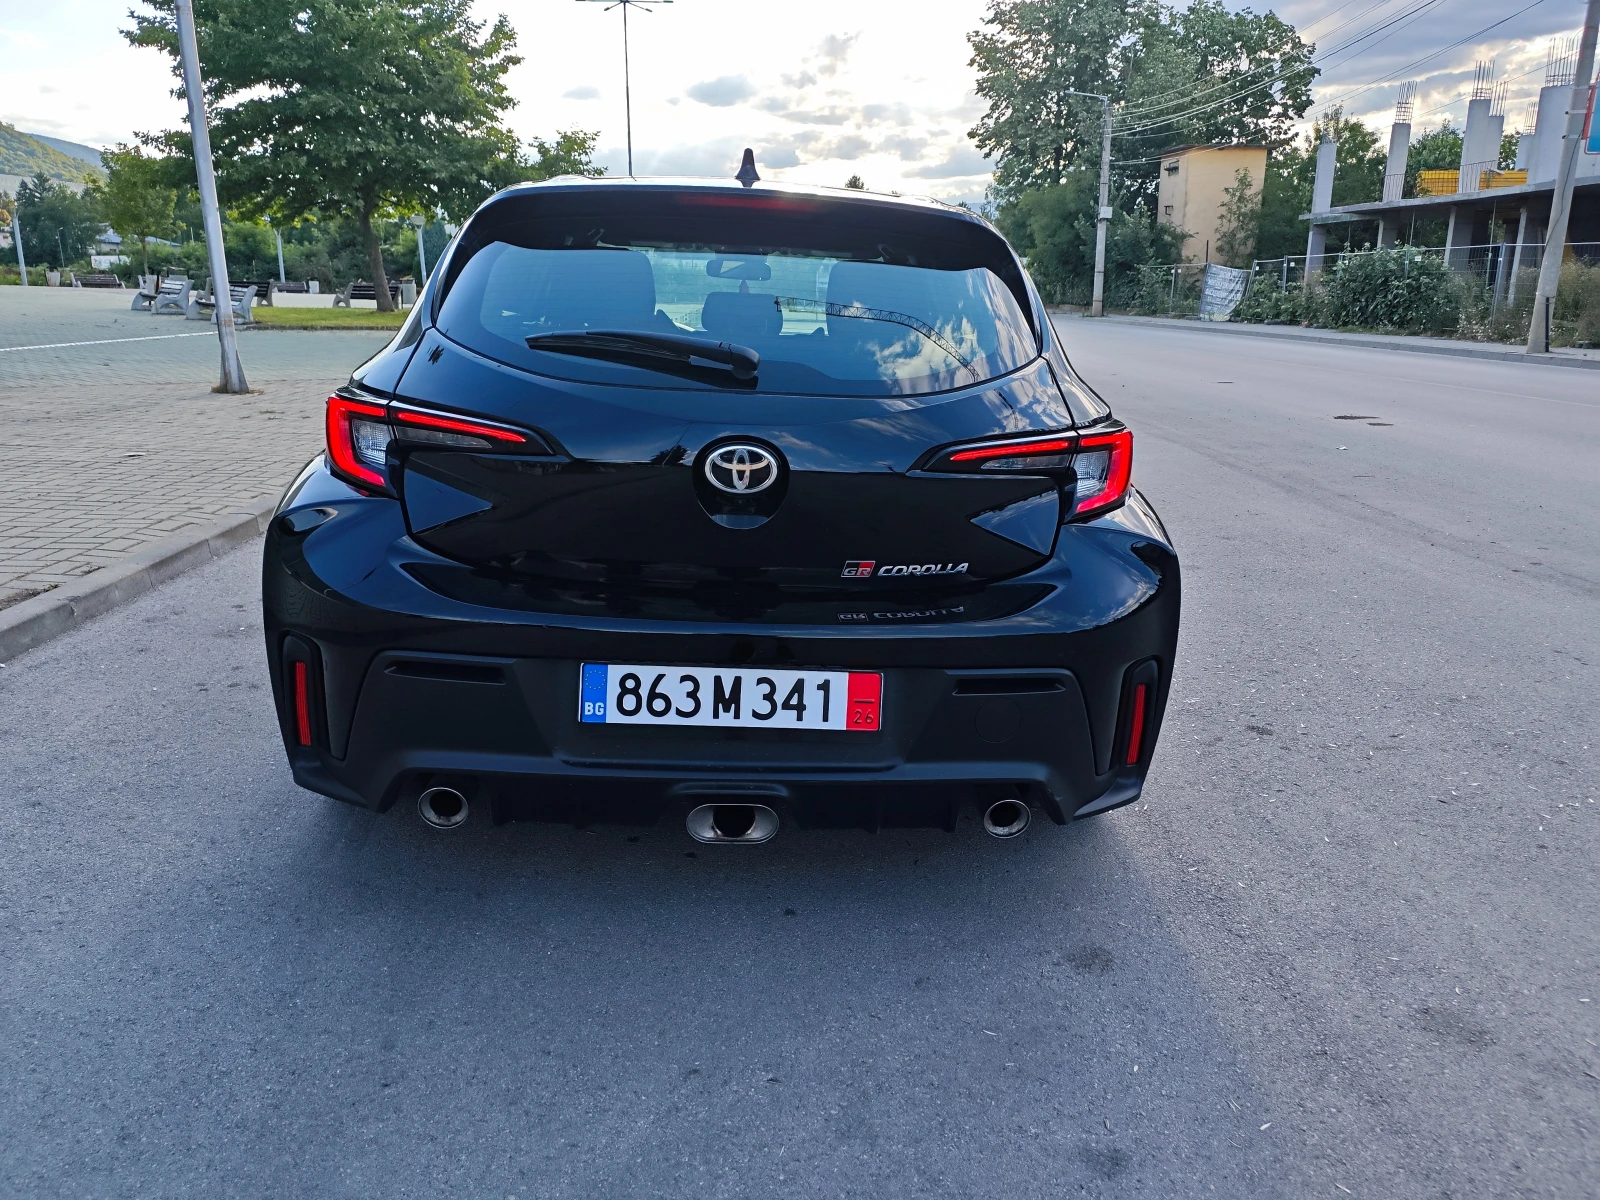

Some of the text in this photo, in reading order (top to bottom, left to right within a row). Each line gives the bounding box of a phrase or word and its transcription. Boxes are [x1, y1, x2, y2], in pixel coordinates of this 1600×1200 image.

[842, 562, 969, 577] GR COROLLA
[584, 701, 605, 716] BG
[853, 709, 874, 724] 26
